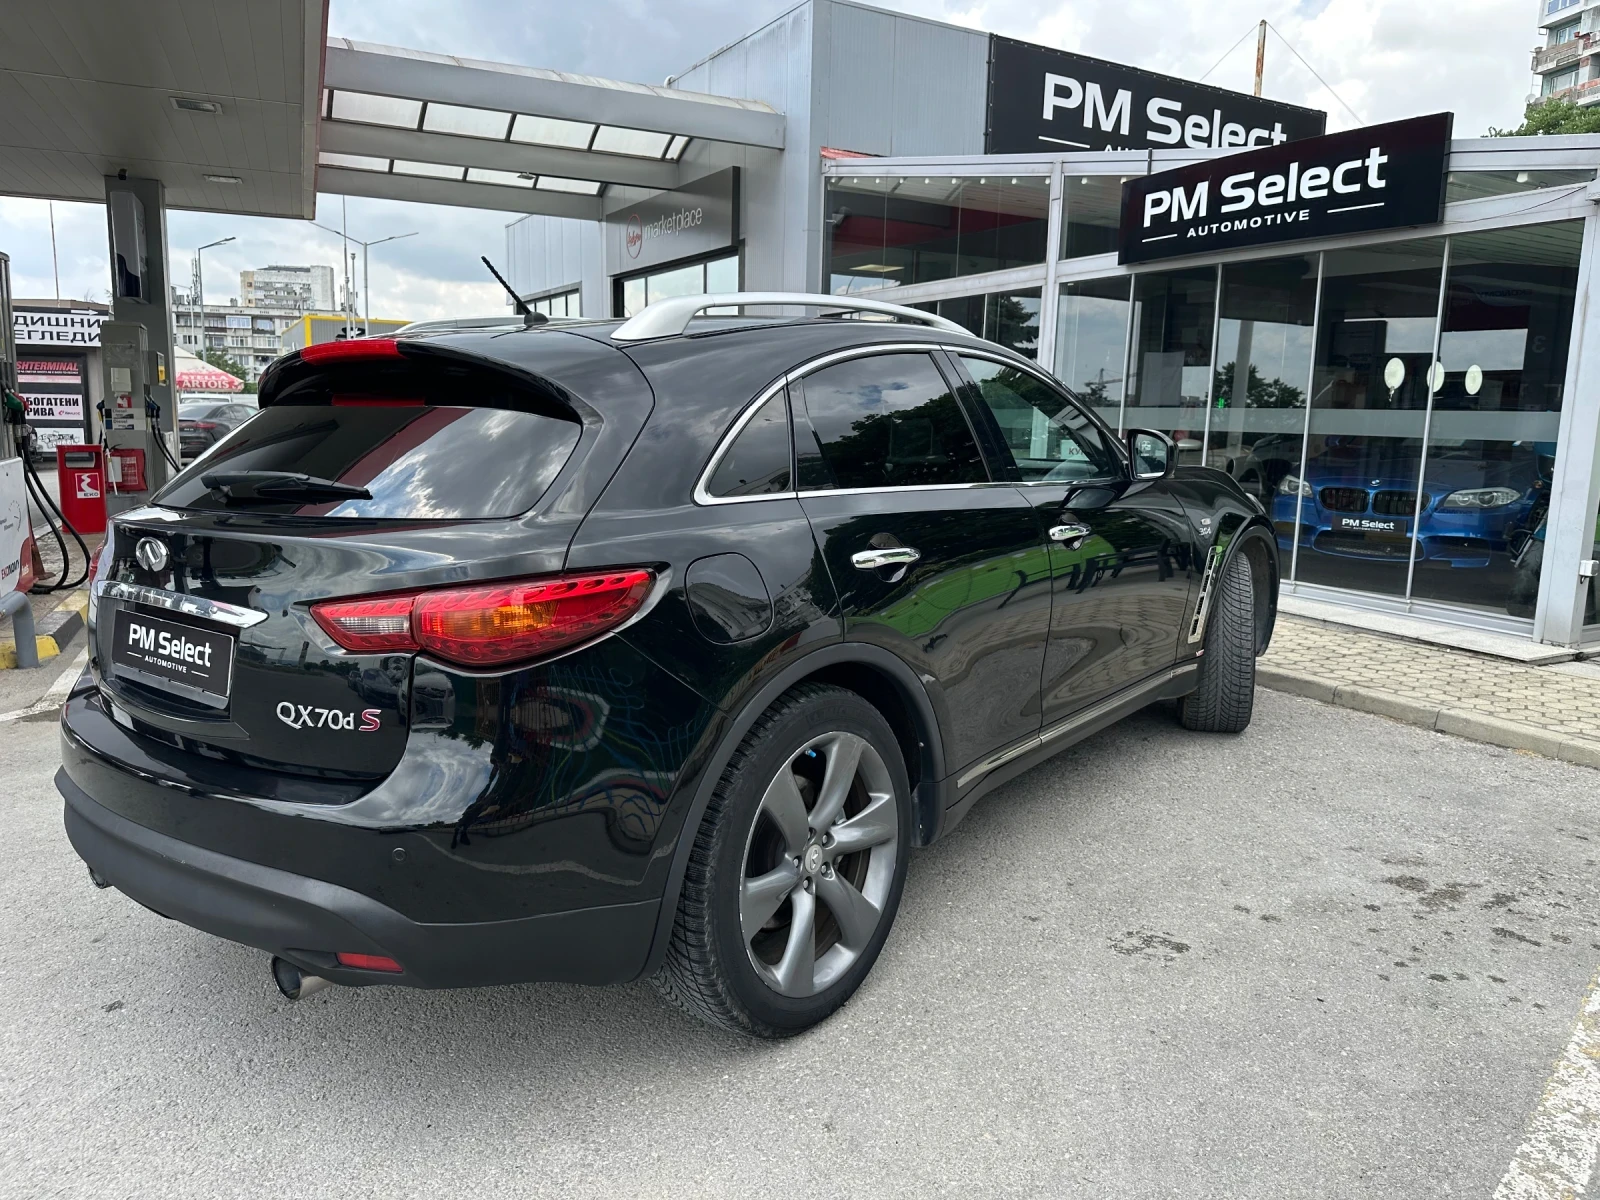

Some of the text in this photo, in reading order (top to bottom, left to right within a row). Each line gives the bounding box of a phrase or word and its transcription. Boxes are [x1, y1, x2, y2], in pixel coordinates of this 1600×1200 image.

[1043, 72, 1287, 148] PM Select
[1143, 147, 1388, 228] PM Select
[645, 207, 703, 240] marketplace
[1187, 209, 1310, 238] AUTOMOTIVE
[182, 380, 230, 389] ARTOIS
[1341, 518, 1395, 529] PM Select
[128, 623, 212, 668] PM Select
[144, 655, 187, 674] AUTOMOTIVE
[276, 701, 382, 732] QX70d S
